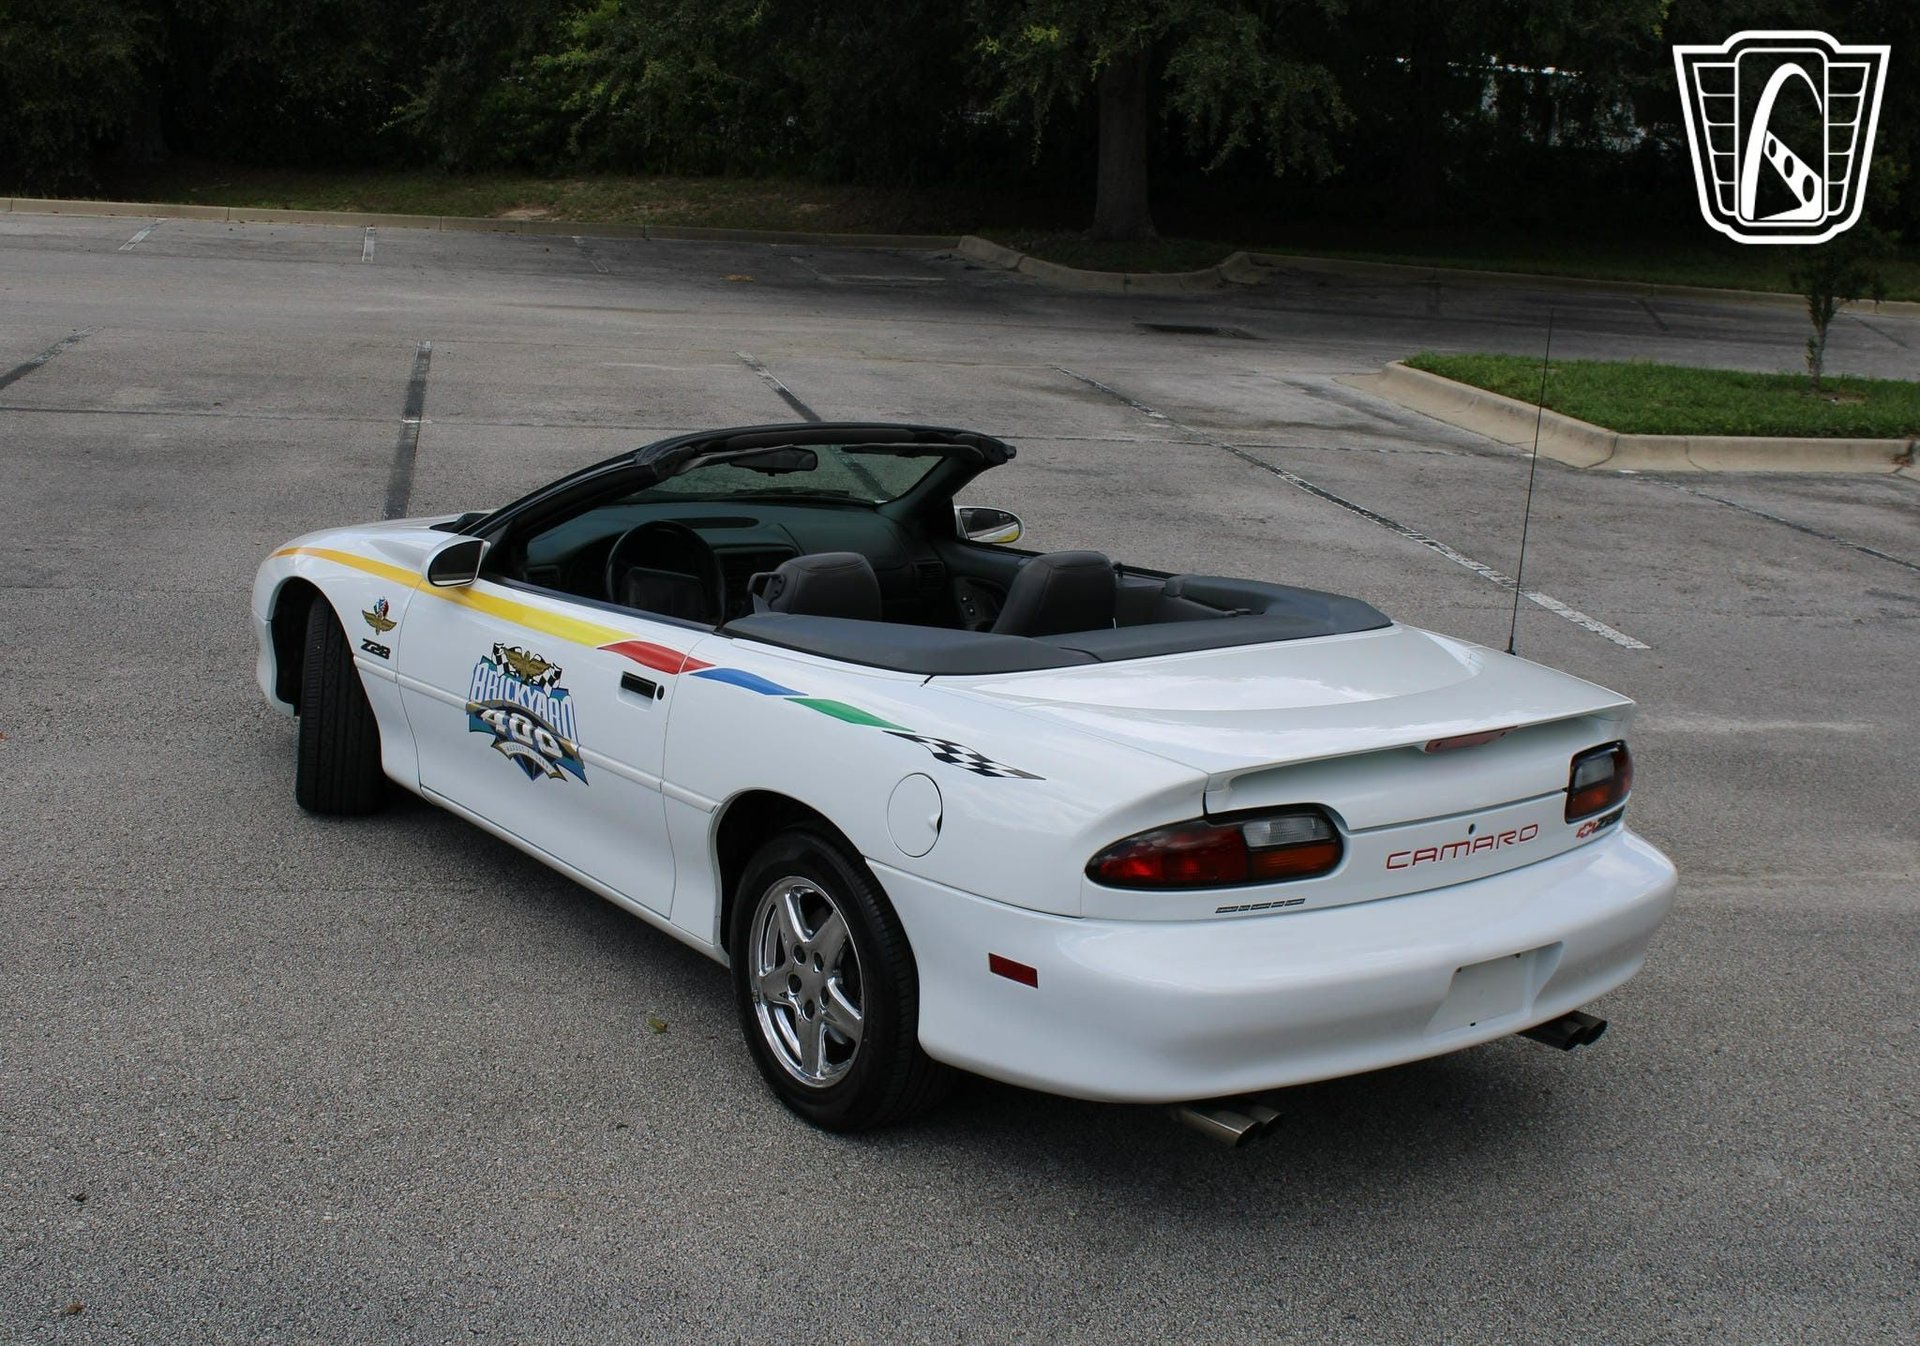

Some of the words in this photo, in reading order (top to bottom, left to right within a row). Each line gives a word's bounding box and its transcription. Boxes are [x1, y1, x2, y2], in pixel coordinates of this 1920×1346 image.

[361, 638, 391, 660] Z28
[469, 662, 579, 745] BRICKYARD
[480, 709, 563, 758] 400
[1386, 823, 1539, 869] CAMARO
